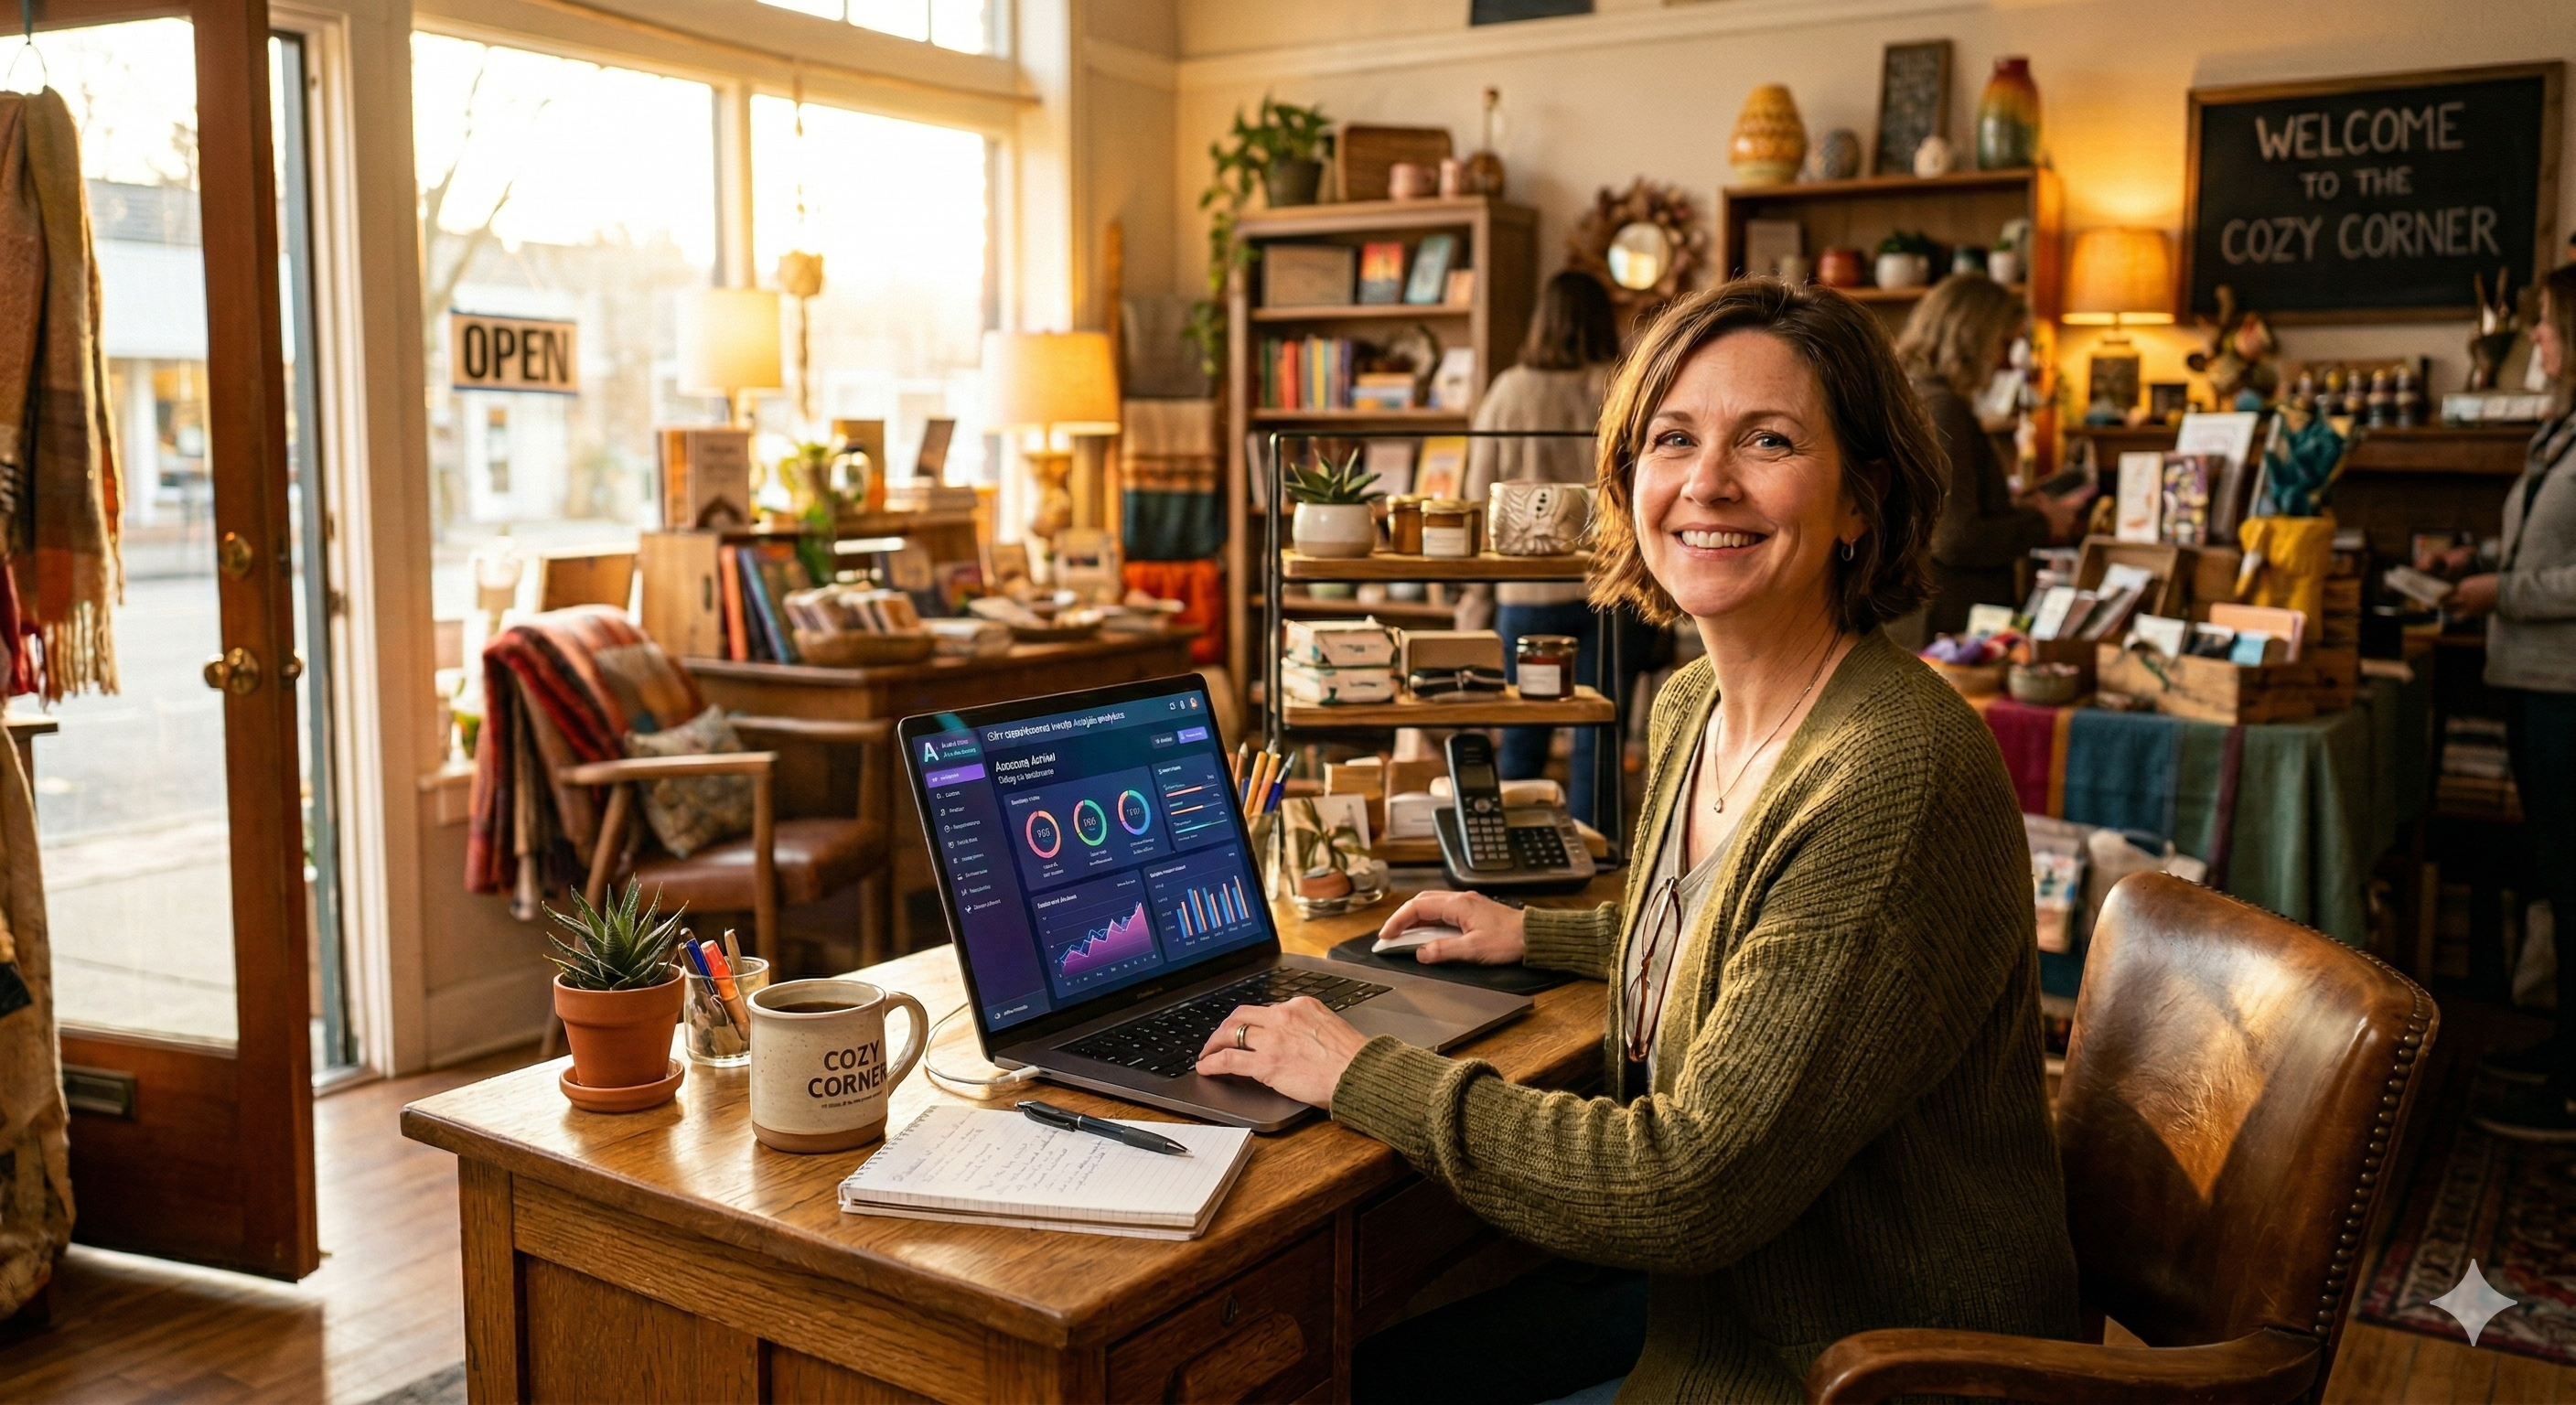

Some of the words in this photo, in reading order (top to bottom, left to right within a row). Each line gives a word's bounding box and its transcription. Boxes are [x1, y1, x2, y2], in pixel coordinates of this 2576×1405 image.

[2254, 101, 2465, 162] WELCOME
[2299, 170, 2341, 200] TO
[2352, 165, 2414, 198] THE
[2220, 214, 2324, 266] COZY
[2336, 204, 2502, 261] CORNER
[464, 324, 569, 384] OPEN
[823, 1039, 881, 1071] COZY
[807, 1061, 887, 1099] CORNER
